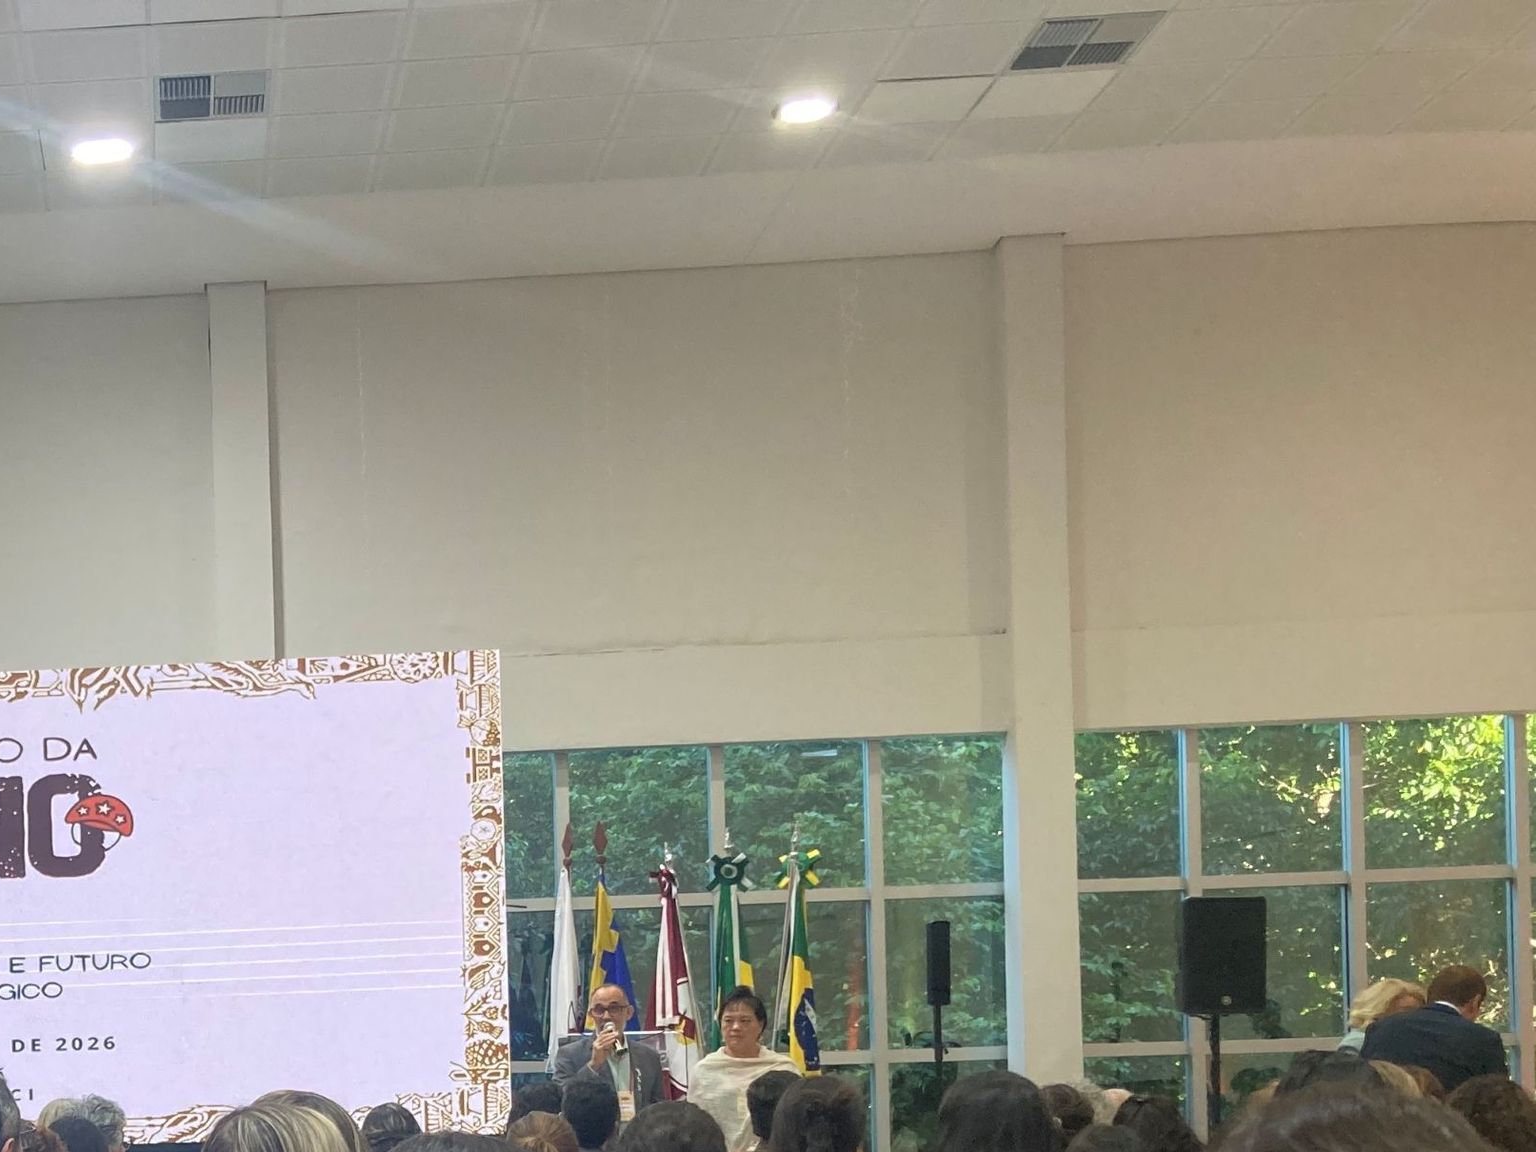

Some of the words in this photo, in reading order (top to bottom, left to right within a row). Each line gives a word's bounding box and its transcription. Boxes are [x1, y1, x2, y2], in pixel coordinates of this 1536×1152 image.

[43, 736, 98, 761] DA
[9, 957, 26, 974] E
[38, 952, 152, 973] FUTURO
[11, 1038, 41, 1053] DE
[55, 1036, 116, 1052] 2026
